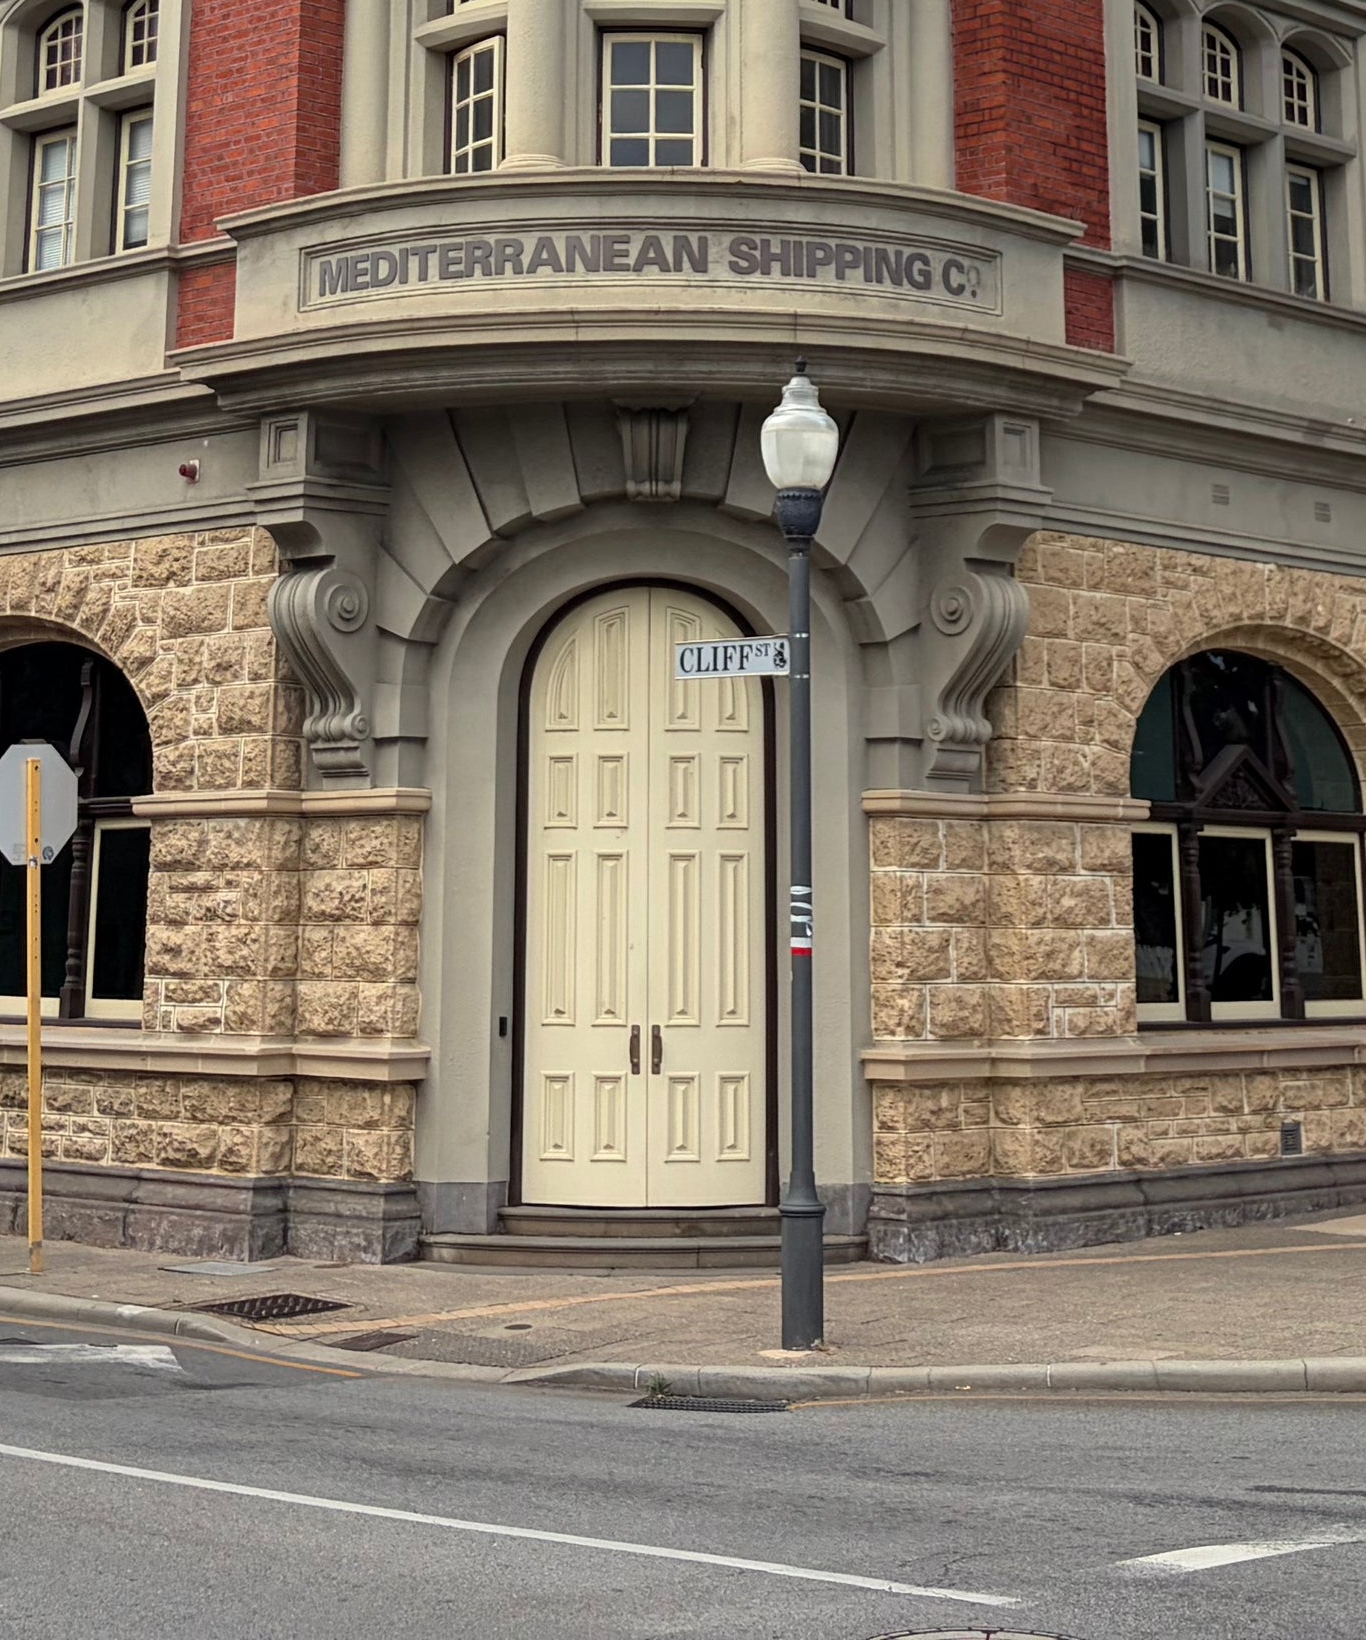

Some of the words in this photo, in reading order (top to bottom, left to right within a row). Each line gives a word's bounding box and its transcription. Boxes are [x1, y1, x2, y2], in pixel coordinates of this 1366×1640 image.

[318, 234, 709, 297] MEDITERRANEAN
[728, 236, 932, 291] SHIPPING
[679, 644, 754, 673] CLIFF
[755, 643, 771, 657] ST
